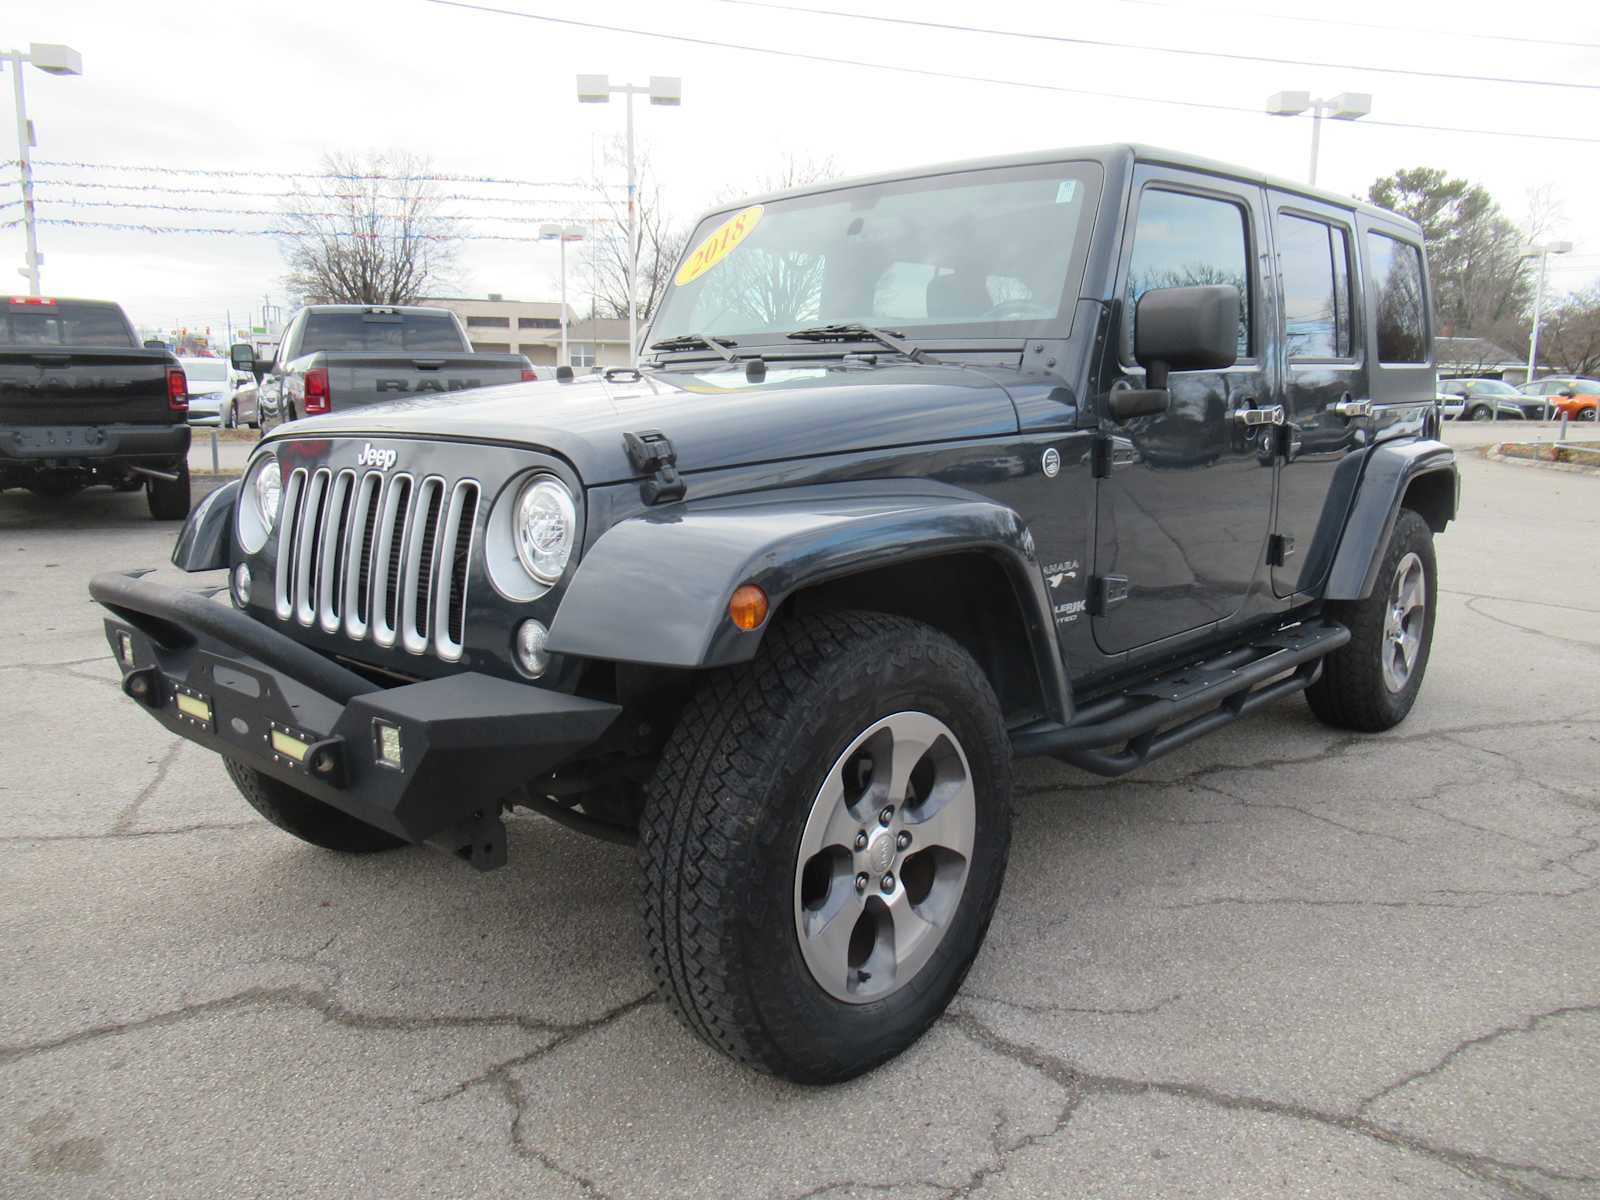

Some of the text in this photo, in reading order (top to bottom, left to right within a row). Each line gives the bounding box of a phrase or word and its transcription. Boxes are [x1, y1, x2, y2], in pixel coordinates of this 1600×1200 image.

[689, 213, 748, 277] 2018
[376, 379, 480, 392] RAM
[358, 443, 396, 471] Jeep
